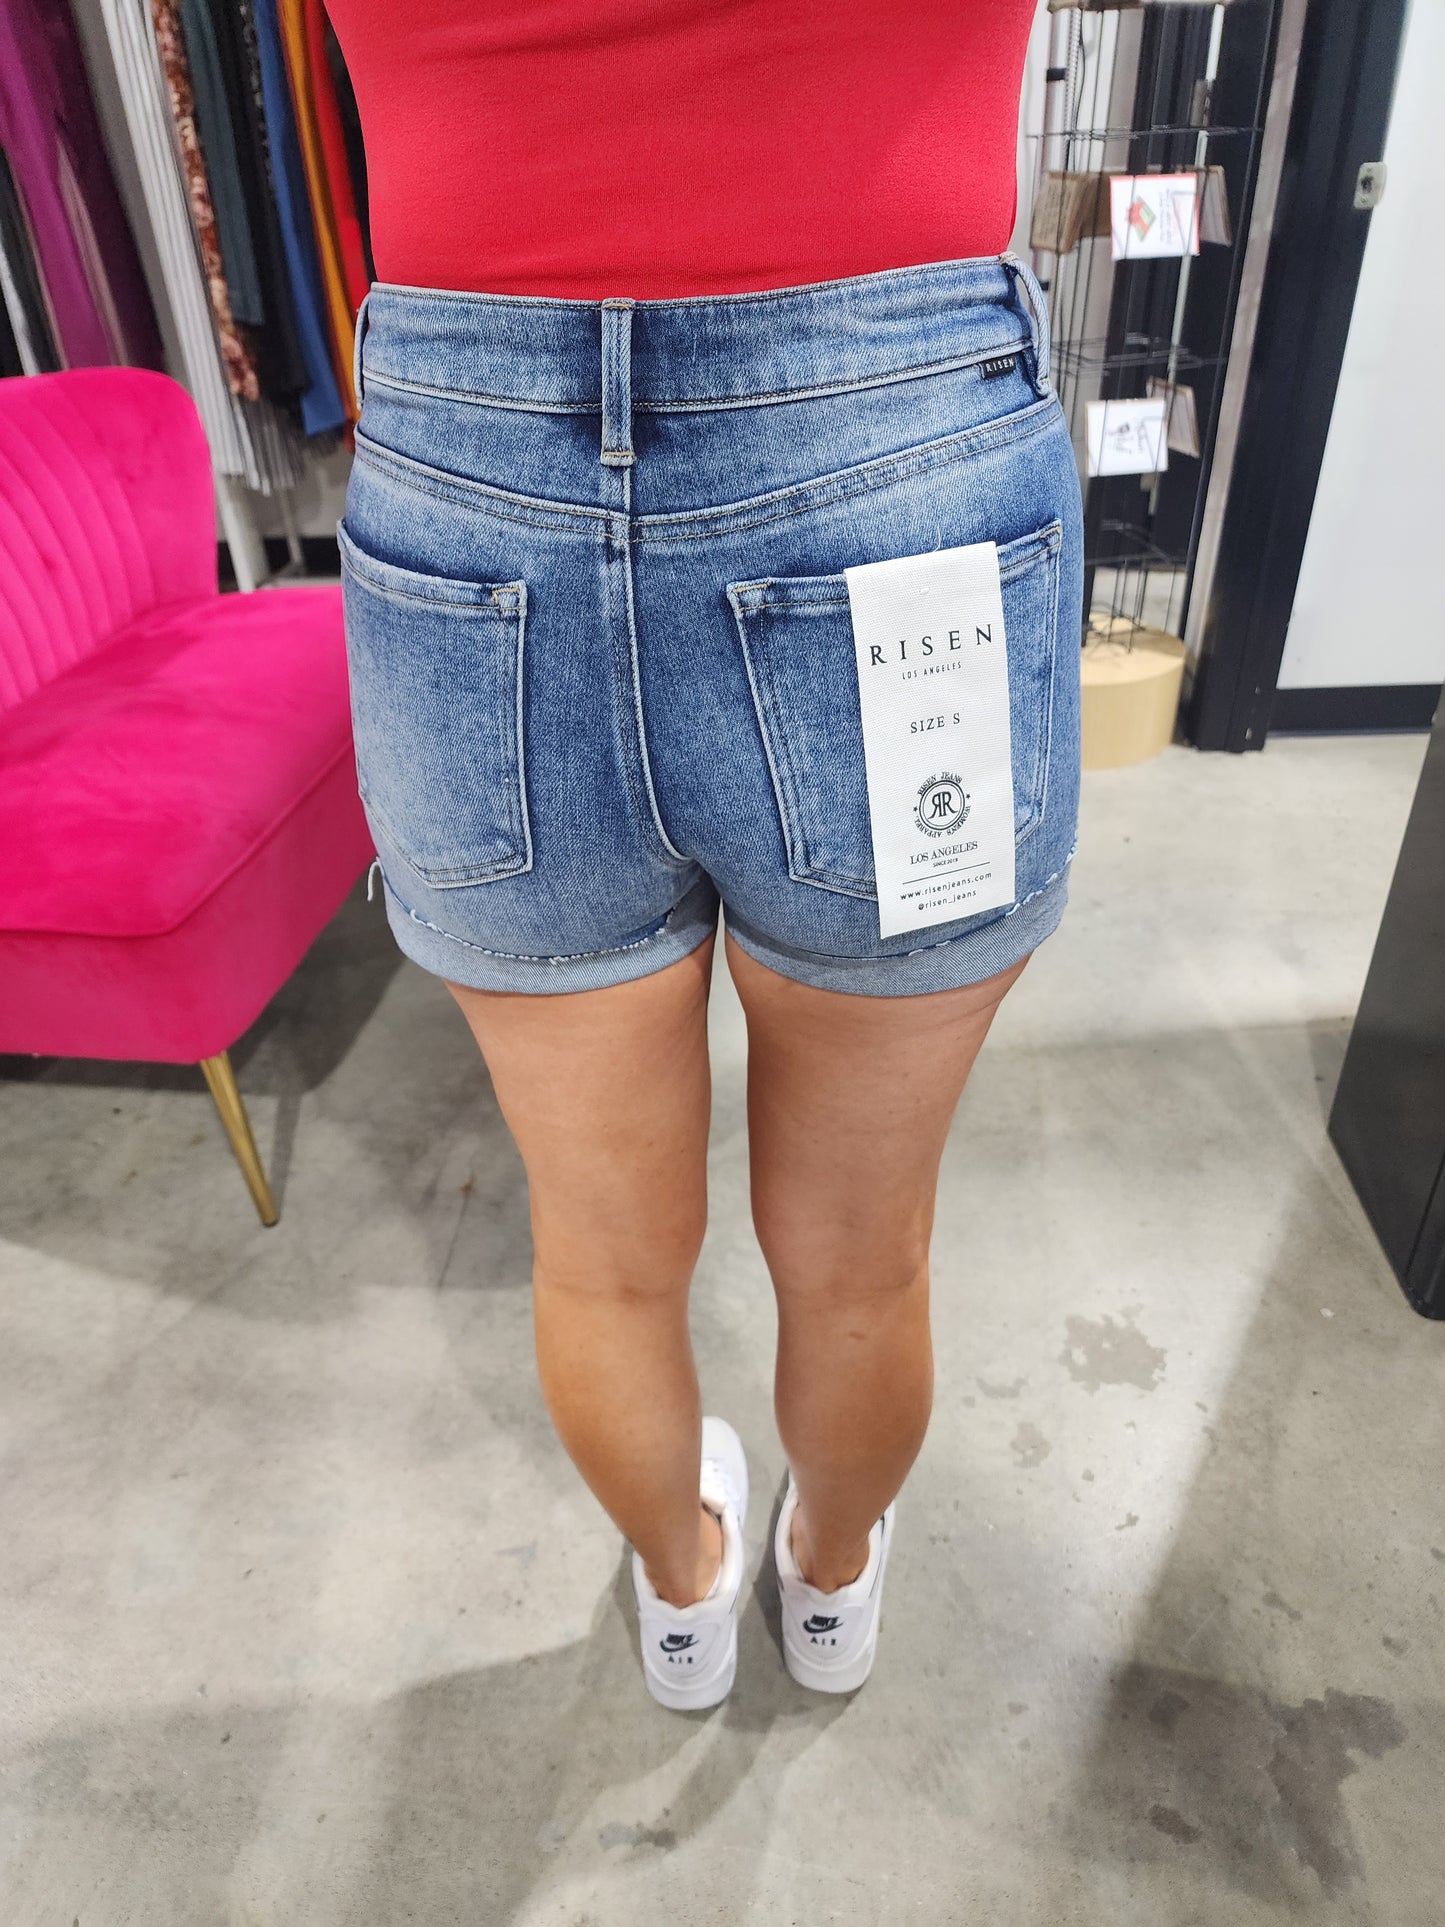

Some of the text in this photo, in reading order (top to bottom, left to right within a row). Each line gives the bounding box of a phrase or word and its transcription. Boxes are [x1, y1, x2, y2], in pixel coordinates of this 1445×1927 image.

[985, 358, 1014, 372] RISEN
[869, 623, 993, 666] RISEN
[902, 661, 962, 680] LOS ANGELES
[910, 712, 961, 734] SIZE S
[917, 771, 963, 796] RISEN JEANS
[910, 840, 978, 865] LOS ANGELES
[932, 860, 947, 868] SINCE
[900, 872, 992, 900] www.risenjeans.com
[918, 889, 977, 911] @risen_jeans
[810, 1614, 840, 1627] NIKE
[665, 1633, 694, 1646] NIKE
[810, 1636, 838, 1647] AIR
[667, 1655, 694, 1665] AIR
